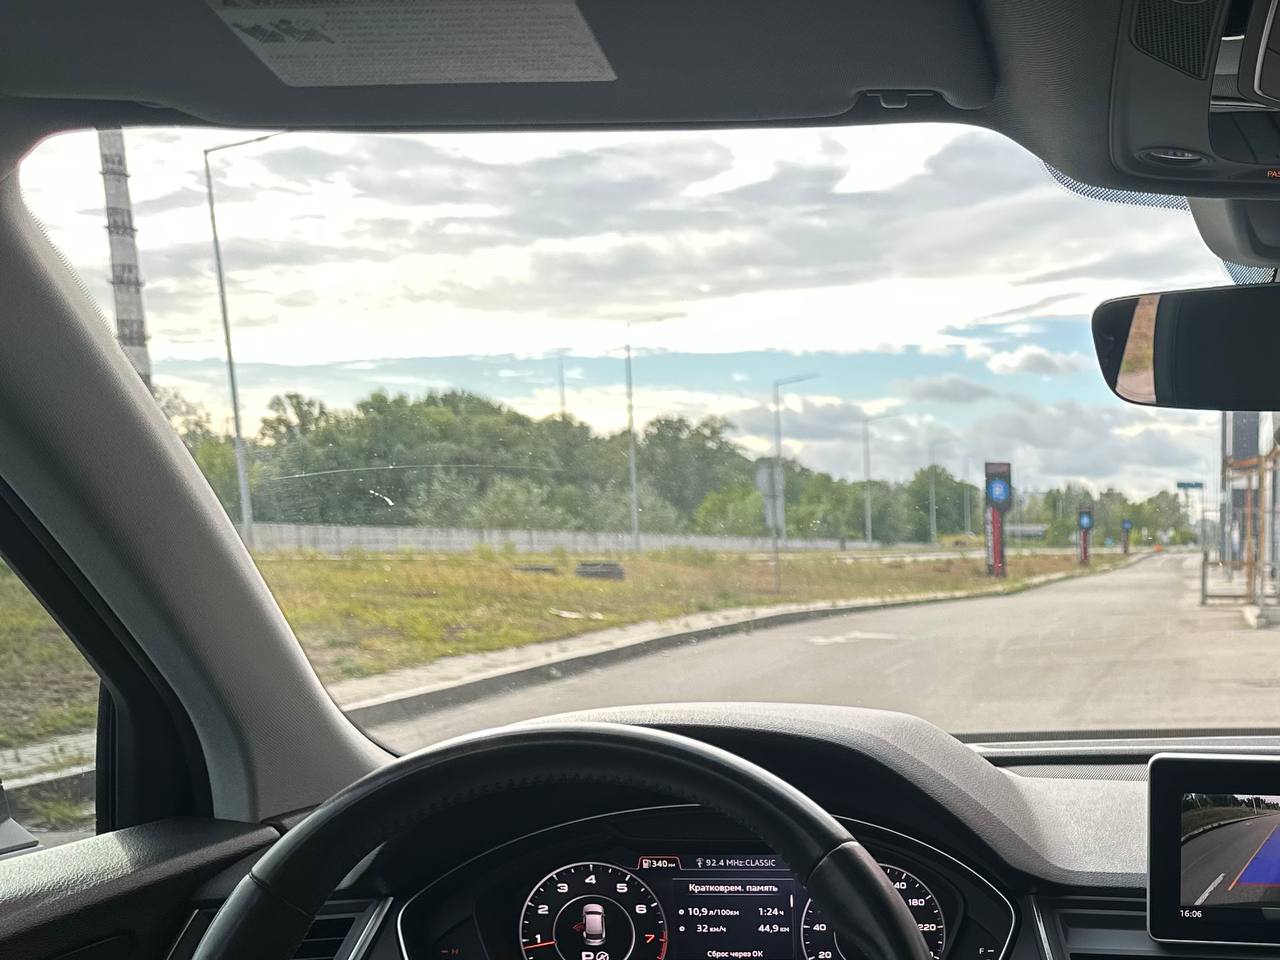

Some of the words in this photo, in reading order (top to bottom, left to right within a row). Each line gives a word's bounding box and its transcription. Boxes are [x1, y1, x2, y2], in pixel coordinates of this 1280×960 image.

[585, 875, 596, 884] 4
[557, 883, 568, 892] 3
[616, 883, 628, 893] 5
[688, 884, 744, 894] Кратковрем.
[538, 905, 549, 914] 2
[636, 904, 647, 914] 6
[1179, 909, 1202, 918] 16:06
[758, 924, 779, 933] 44,9
[535, 934, 541, 943] 1
[644, 934, 655, 943] 7
[707, 950, 729, 958] Сброс
